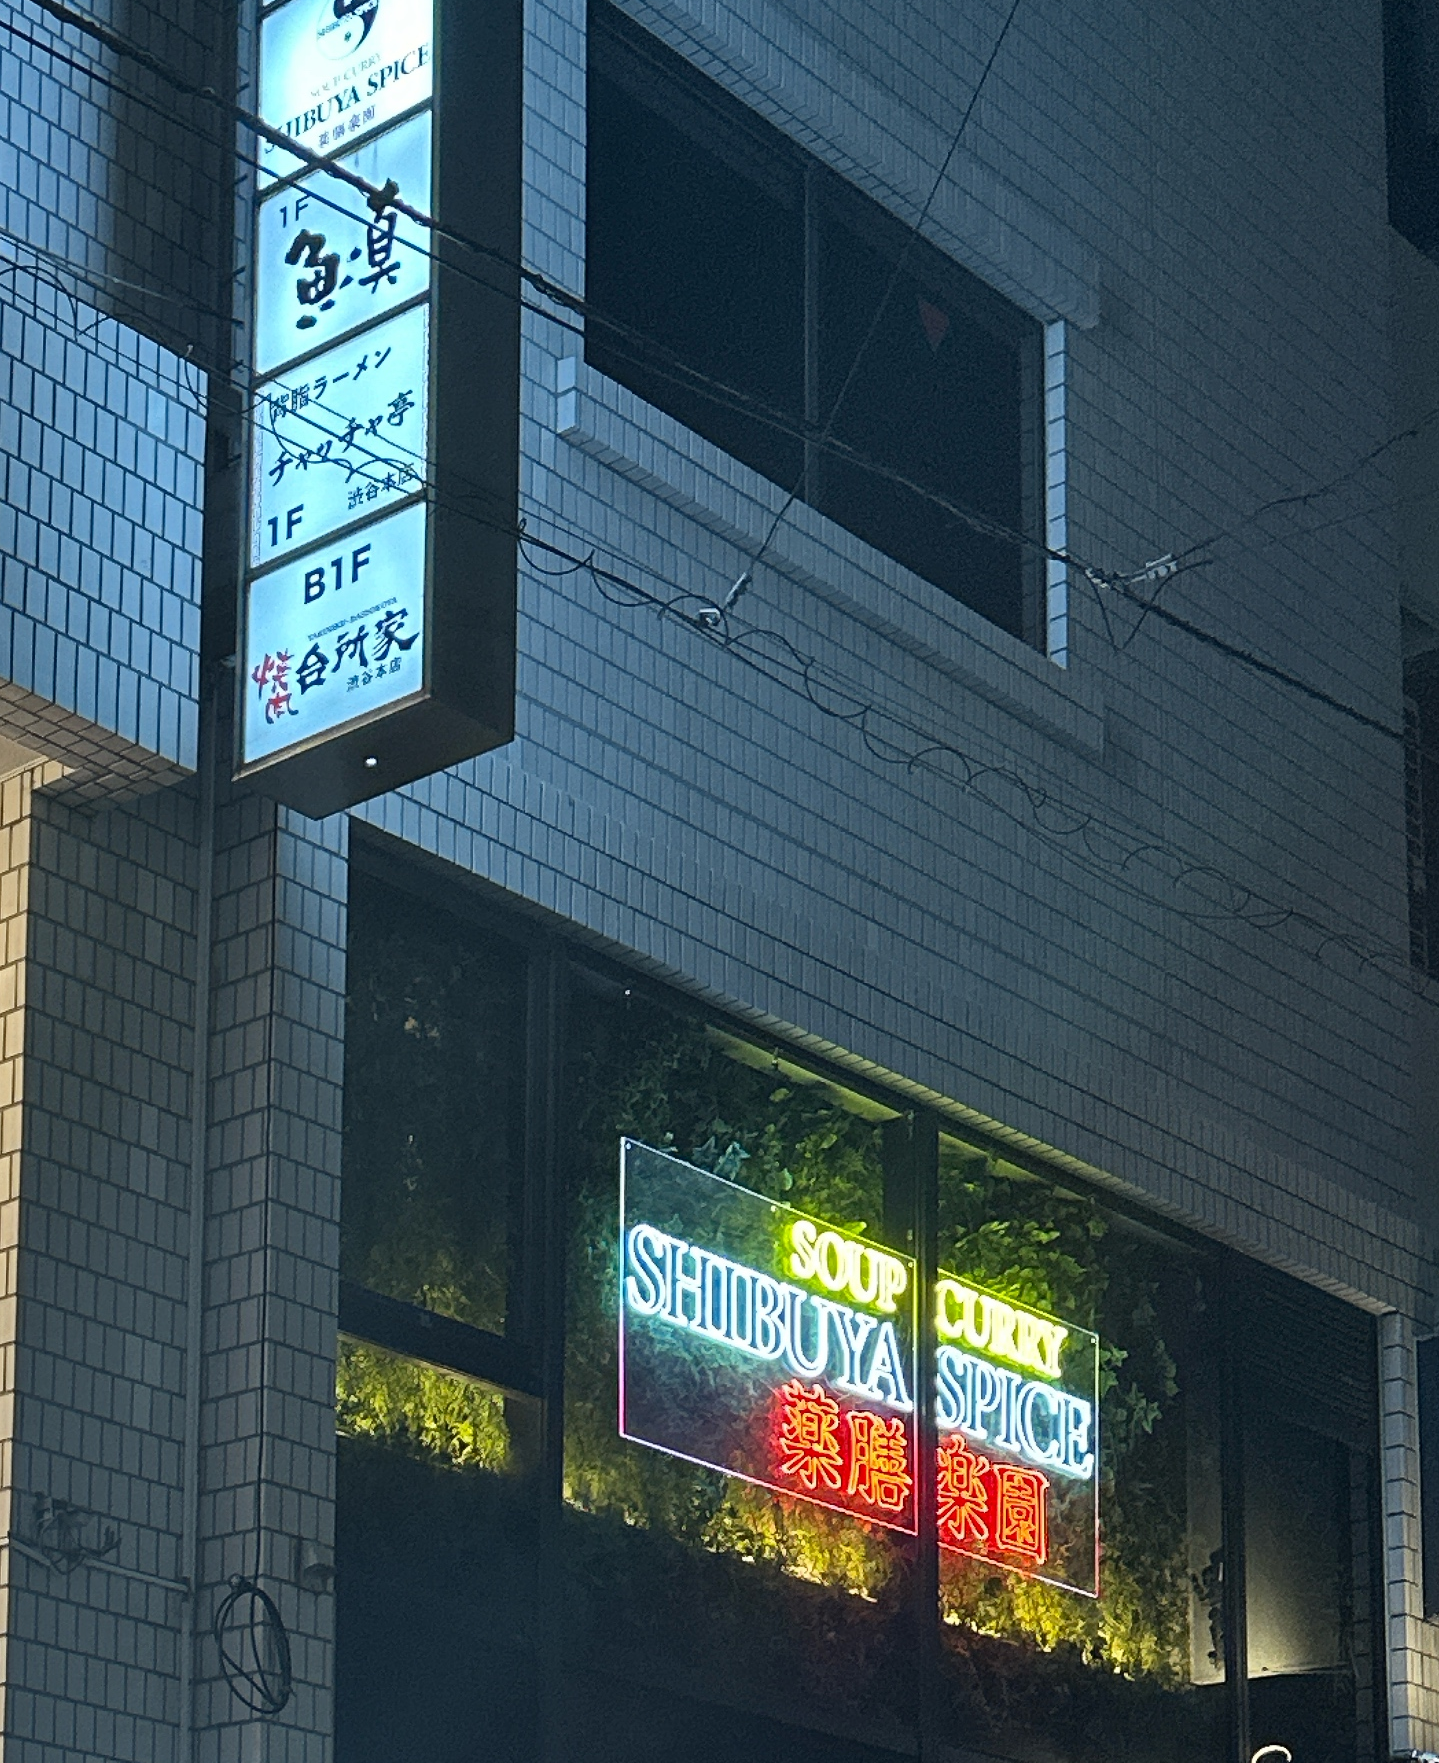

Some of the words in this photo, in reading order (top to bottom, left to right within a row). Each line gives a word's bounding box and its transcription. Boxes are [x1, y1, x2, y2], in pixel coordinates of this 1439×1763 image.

[367, 43, 431, 97] SPICE
[279, 200, 309, 228] 1F
[284, 203, 401, 331] 魚真
[347, 463, 415, 511] 渋谷本店
[267, 504, 304, 547] 1F
[304, 544, 372, 604] B1F
[346, 657, 402, 693] 渋谷本店
[791, 1219, 908, 1313] SOUP
[936, 1280, 1069, 1378] CURRY
[625, 1223, 914, 1411] SHIBUYA
[937, 1346, 1095, 1480] SPICE
